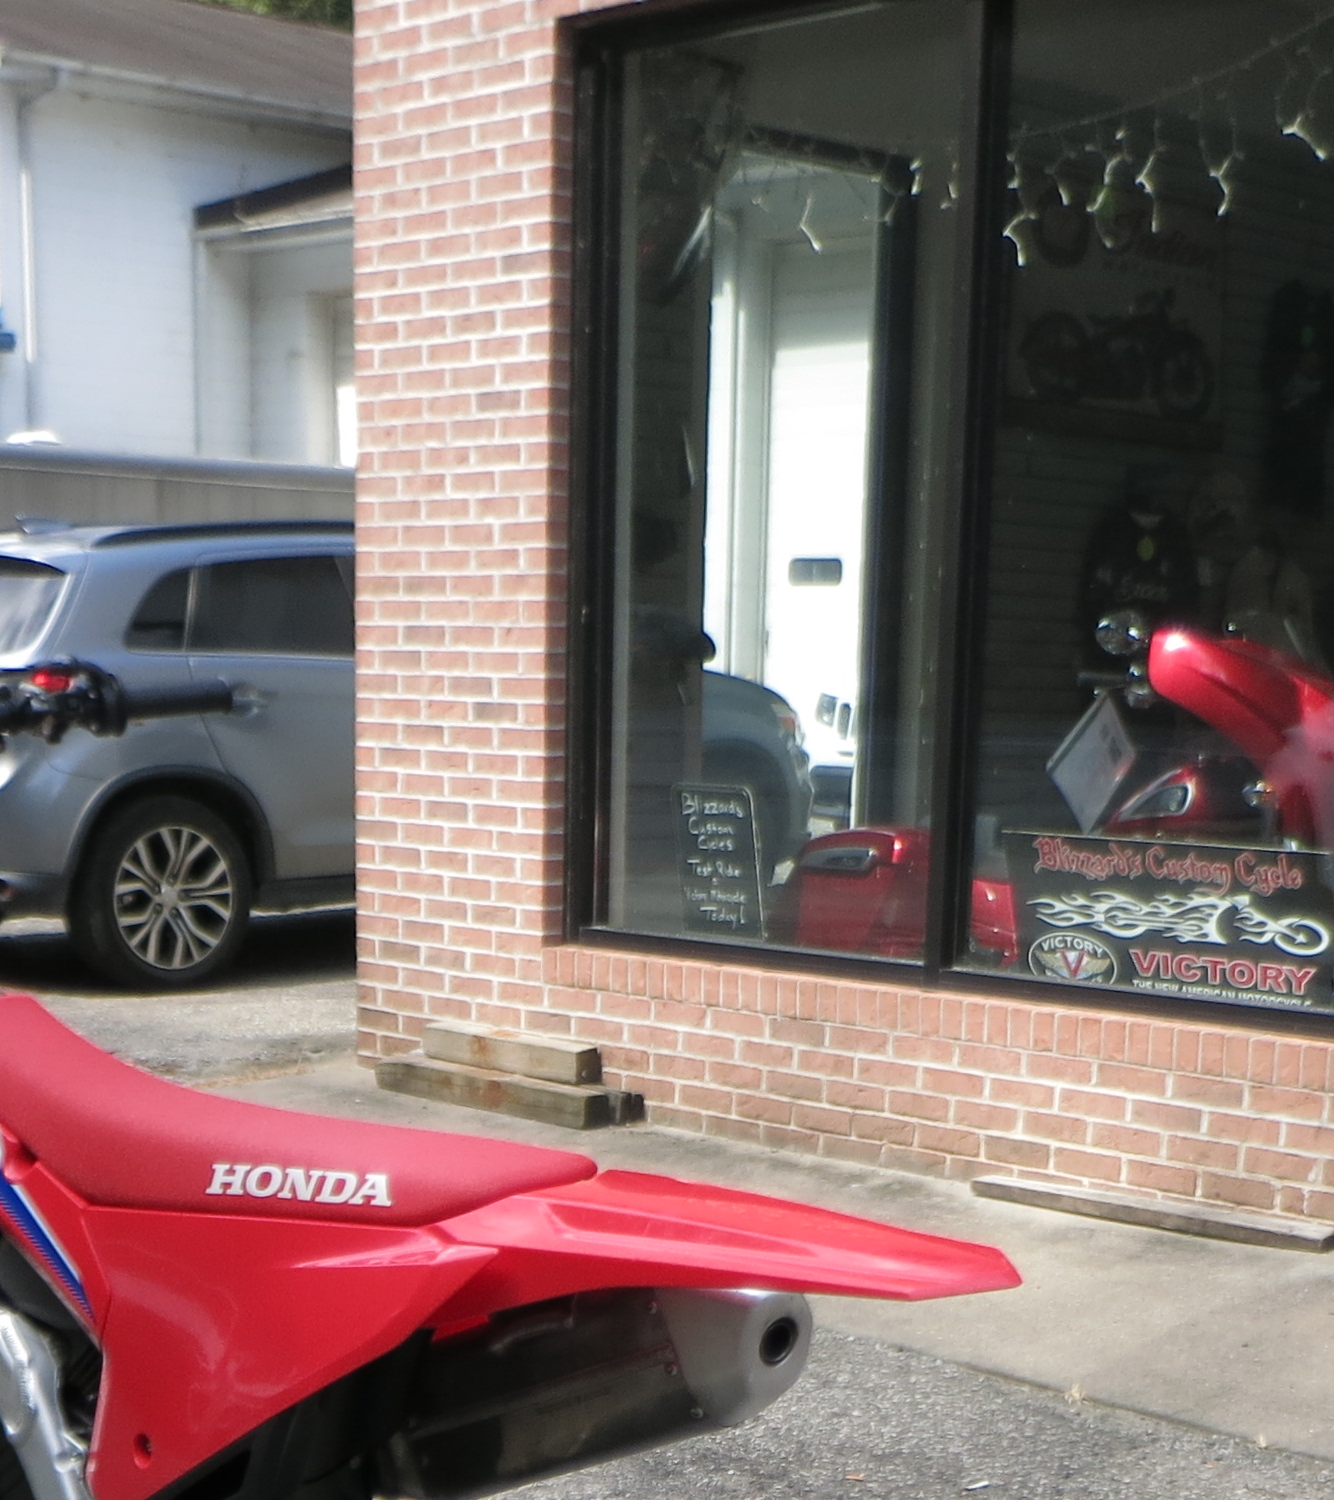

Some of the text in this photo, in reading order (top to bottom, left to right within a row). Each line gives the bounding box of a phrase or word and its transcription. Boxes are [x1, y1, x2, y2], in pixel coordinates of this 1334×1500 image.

[1032, 837, 1302, 897] Blizzard's Custom Cycle
[1040, 935, 1105, 959] VICTORY
[1129, 948, 1317, 996] VICTORY
[205, 1163, 393, 1207] HONDA
